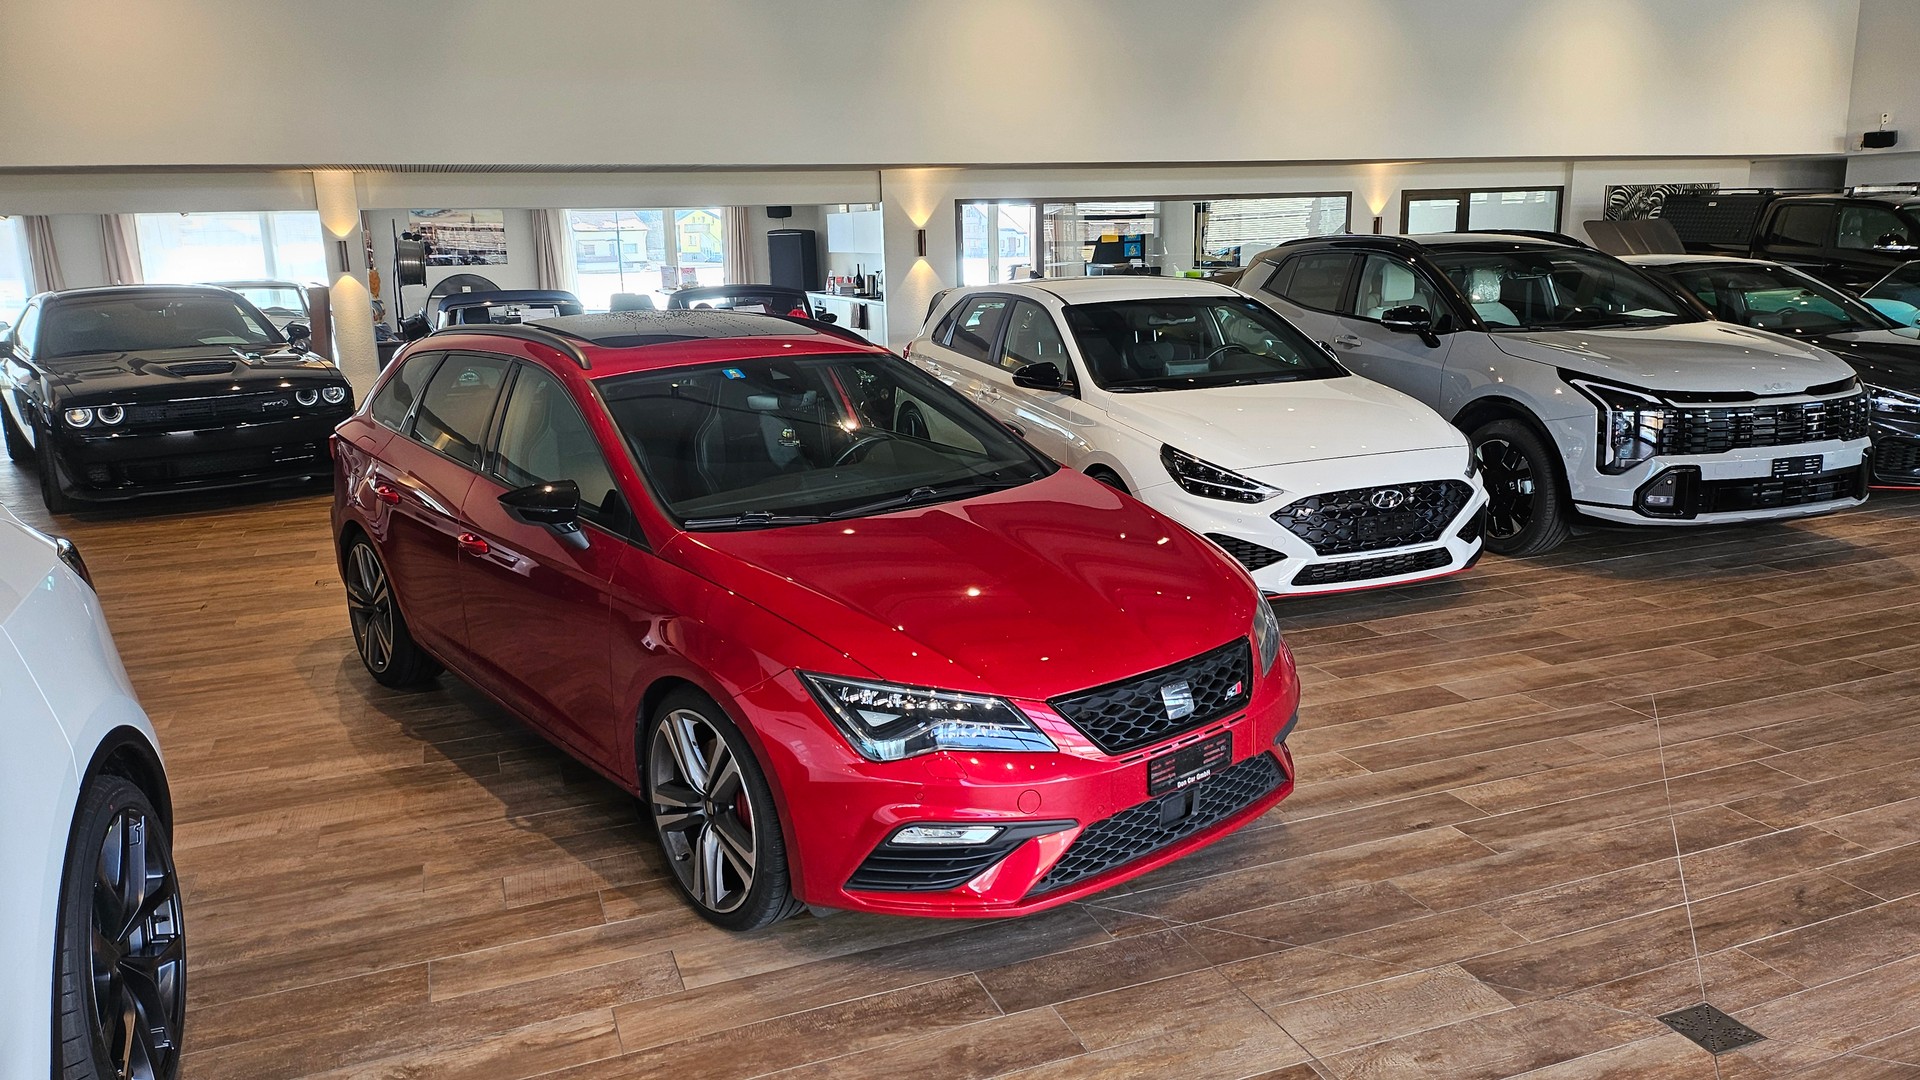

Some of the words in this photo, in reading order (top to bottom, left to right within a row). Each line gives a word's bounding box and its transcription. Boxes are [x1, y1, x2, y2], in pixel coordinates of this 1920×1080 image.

[1177, 779, 1187, 789] Don
[1187, 775, 1196, 784] Car
[1196, 769, 1211, 780] GmbH
